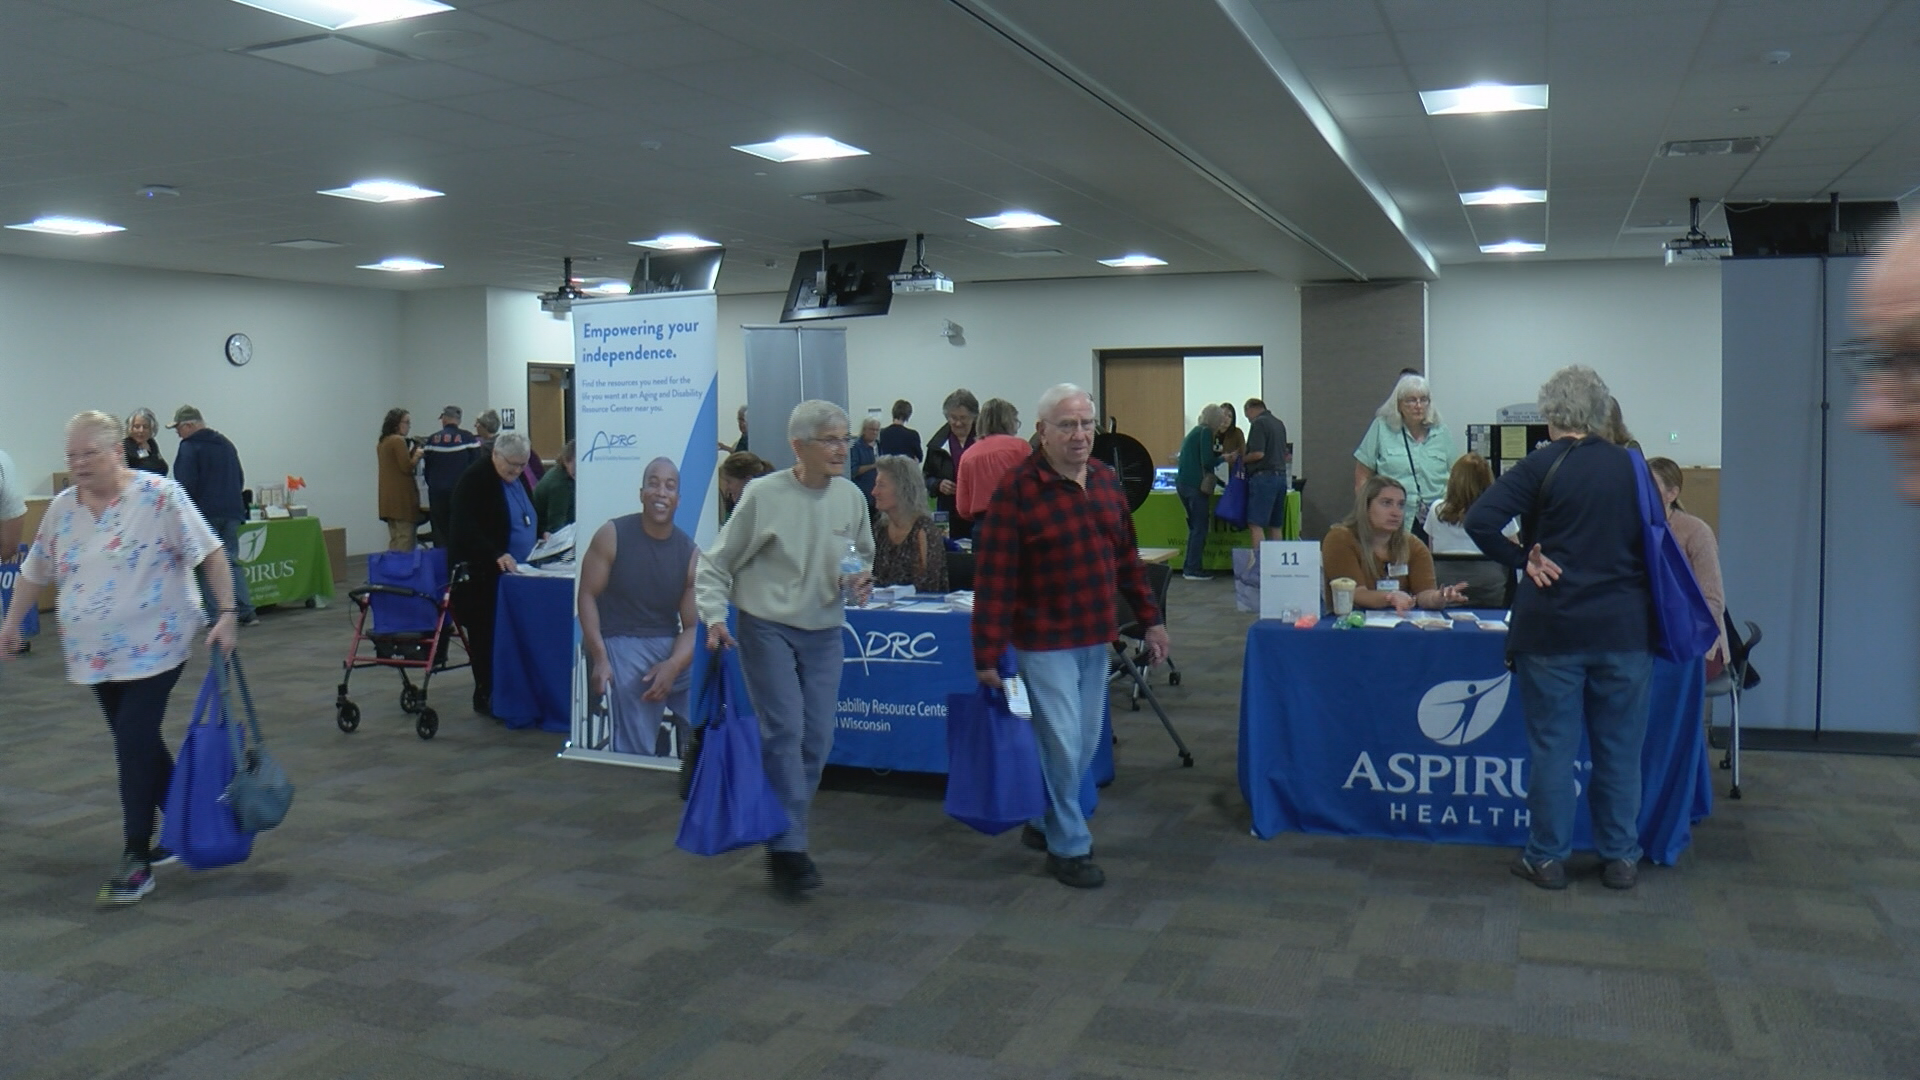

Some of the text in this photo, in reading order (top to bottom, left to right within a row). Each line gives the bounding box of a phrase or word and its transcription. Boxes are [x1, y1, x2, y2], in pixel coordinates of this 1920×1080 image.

[583, 320, 699, 343] Empowering your
[582, 344, 677, 367] independence.
[596, 379, 606, 387] the
[639, 380, 651, 388] you
[652, 377, 668, 385] need
[669, 377, 678, 385] for
[680, 376, 691, 384] the
[591, 394, 603, 402] you
[639, 391, 658, 401] Aging
[659, 390, 671, 398] and
[672, 389, 703, 399] Disability
[582, 405, 609, 413] Resource
[610, 404, 634, 412] Center
[581, 431, 638, 462] ADRC
[1281, 552, 1299, 566] 11
[243, 560, 295, 583] PIRUS
[836, 697, 949, 717] sability Resource Cente
[840, 716, 892, 731] Wisconsin
[1390, 803, 1531, 828] HEALTH
